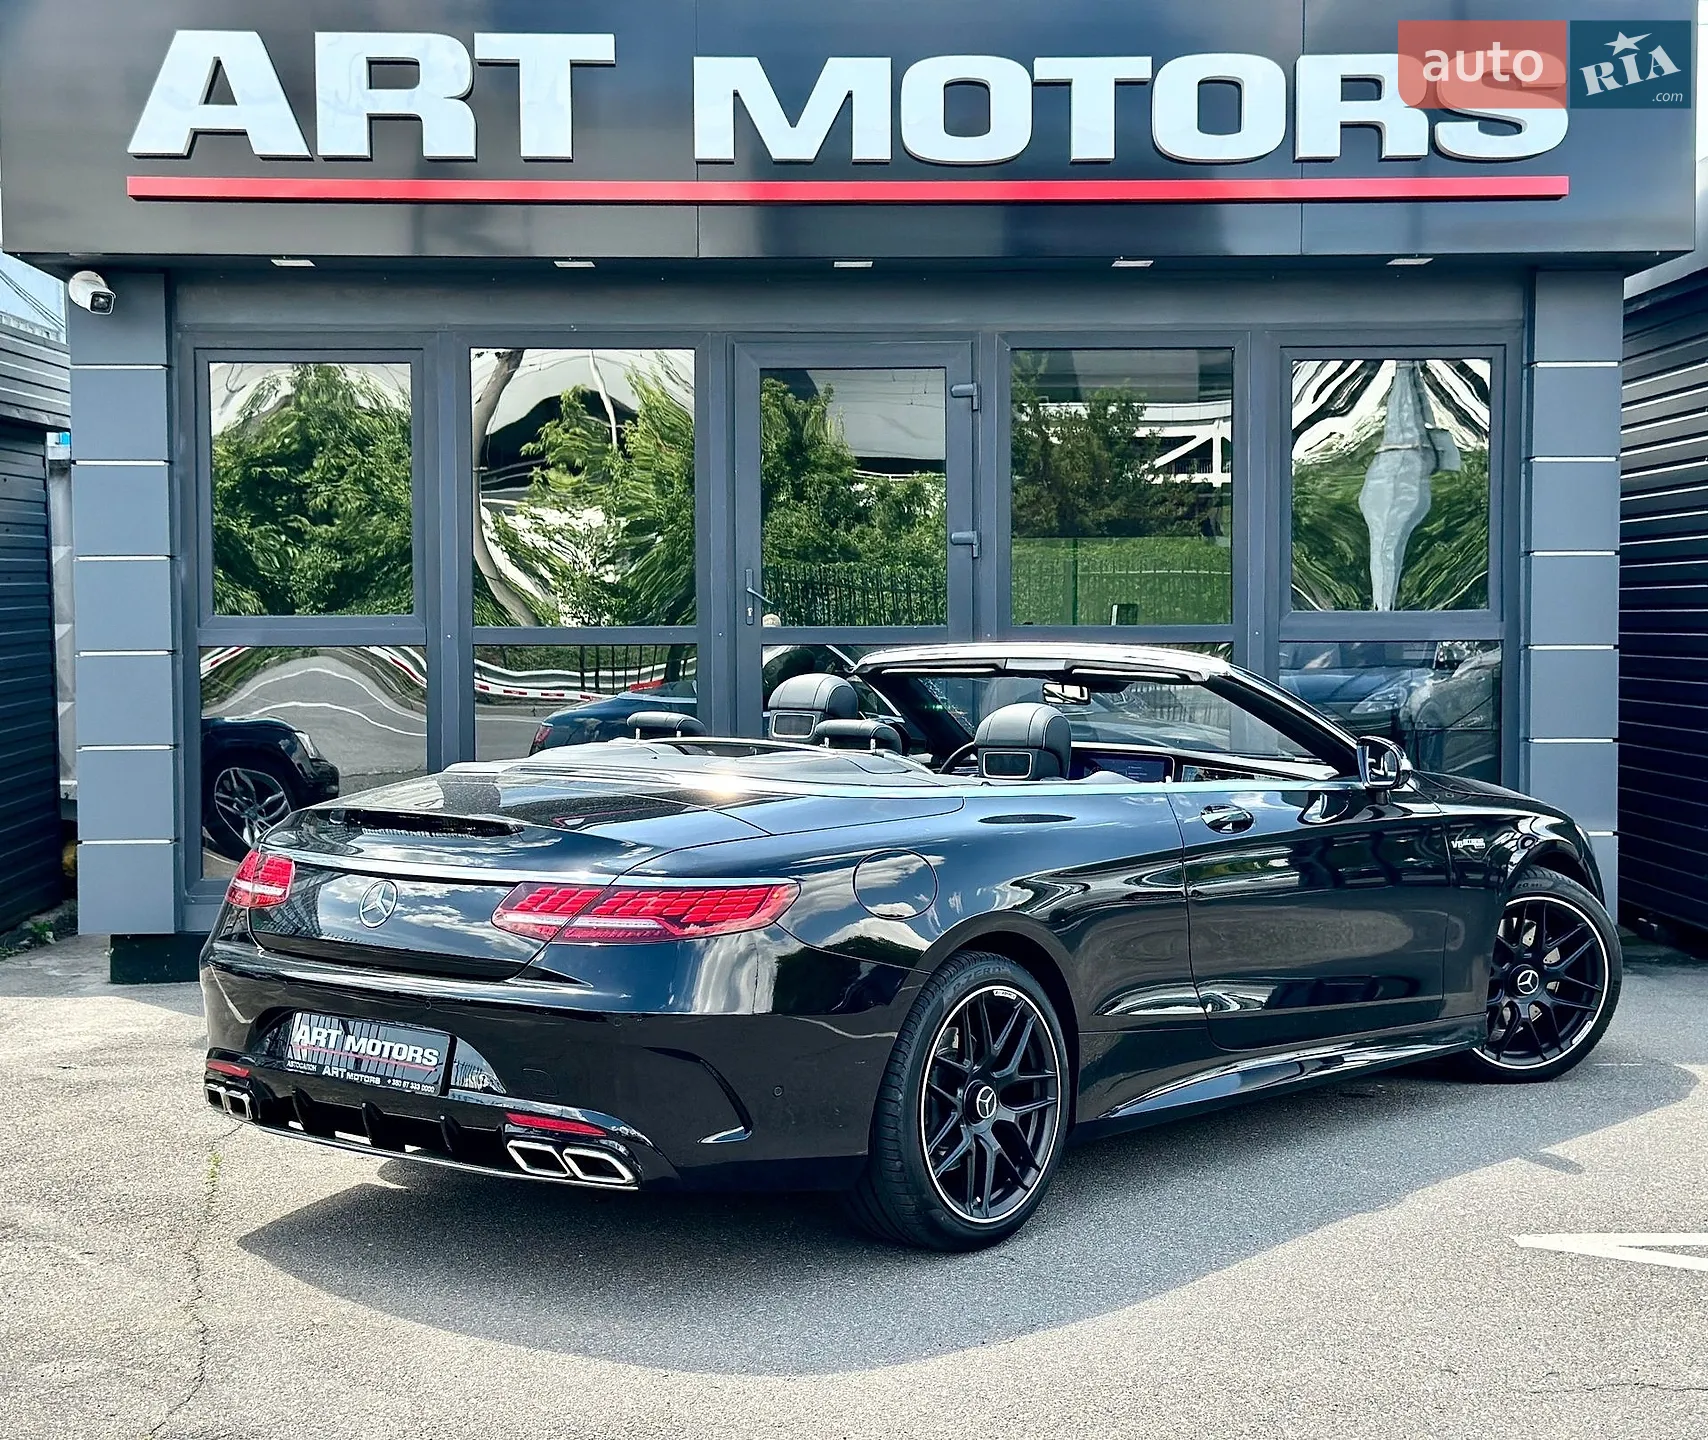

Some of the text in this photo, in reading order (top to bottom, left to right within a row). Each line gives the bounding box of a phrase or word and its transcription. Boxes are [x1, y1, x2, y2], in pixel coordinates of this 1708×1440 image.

[127, 30, 1568, 162] ART MOTORS
[294, 1025, 439, 1067] ART MOTORS
[322, 1065, 381, 1085] ART MOTORS
